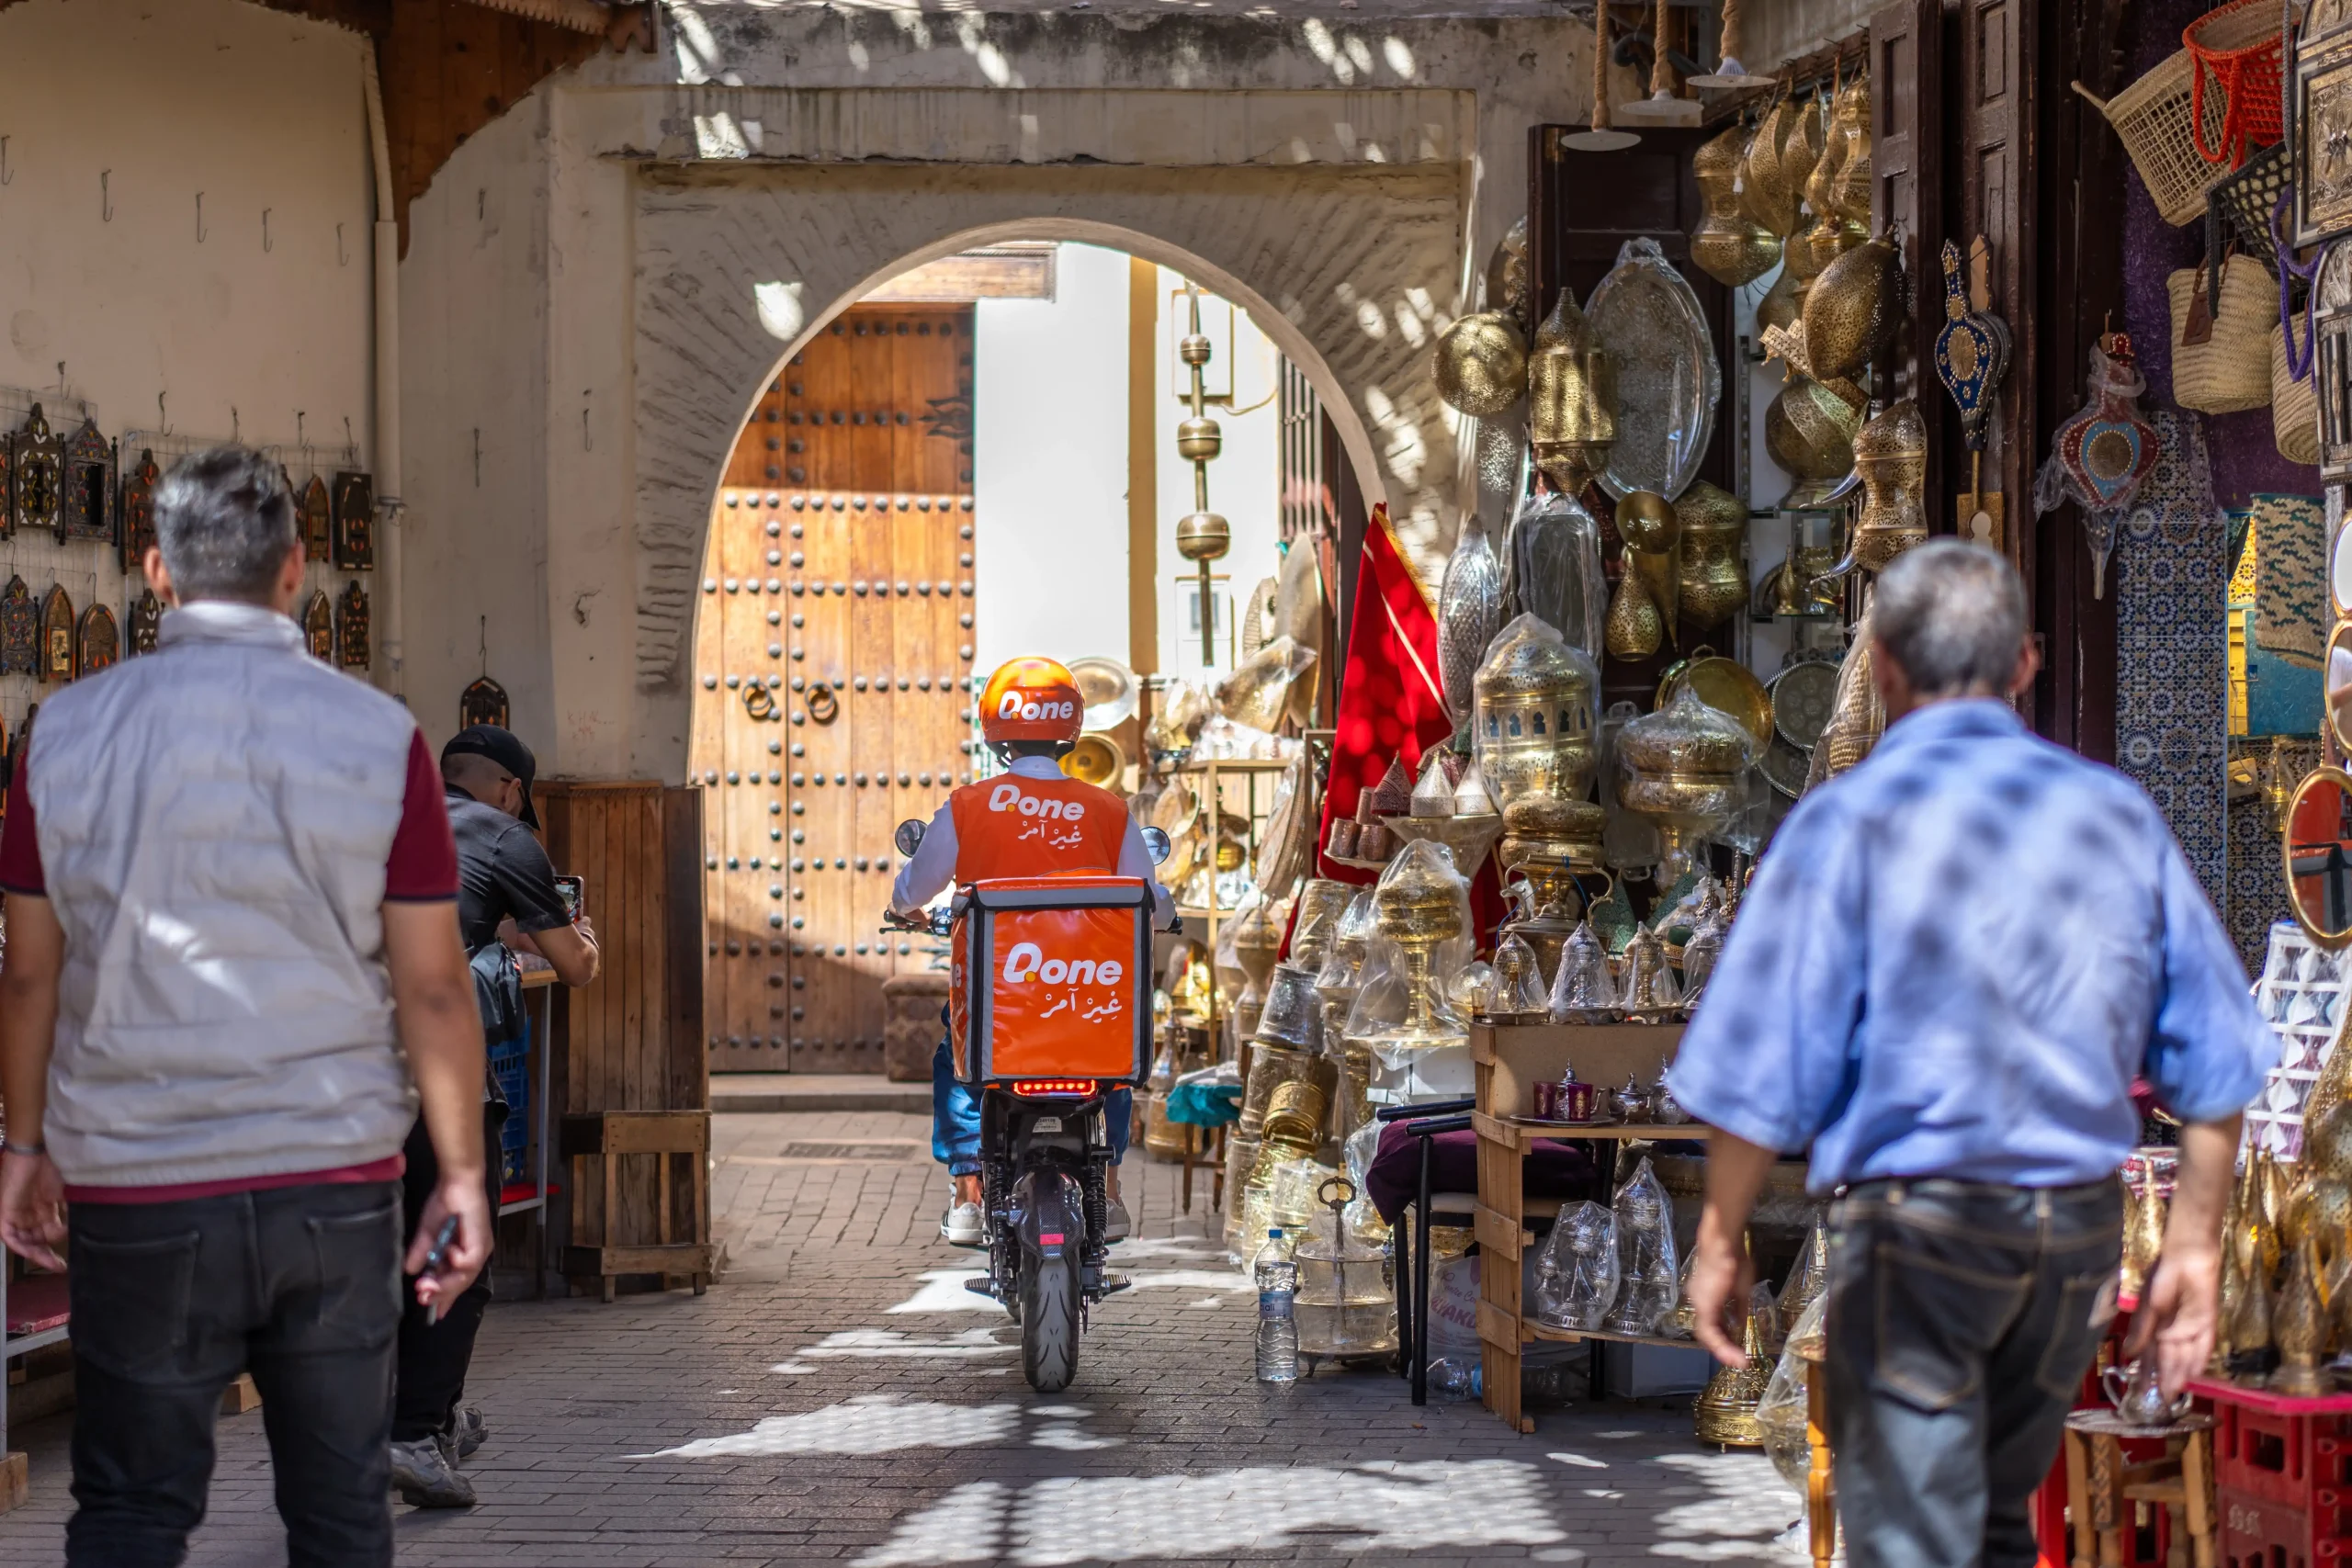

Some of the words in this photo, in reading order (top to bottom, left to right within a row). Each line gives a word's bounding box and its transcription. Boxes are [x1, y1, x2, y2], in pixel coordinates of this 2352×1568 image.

[998, 690, 1074, 720] Done
[989, 784, 1085, 821] Done
[1002, 942, 1123, 986] Done
